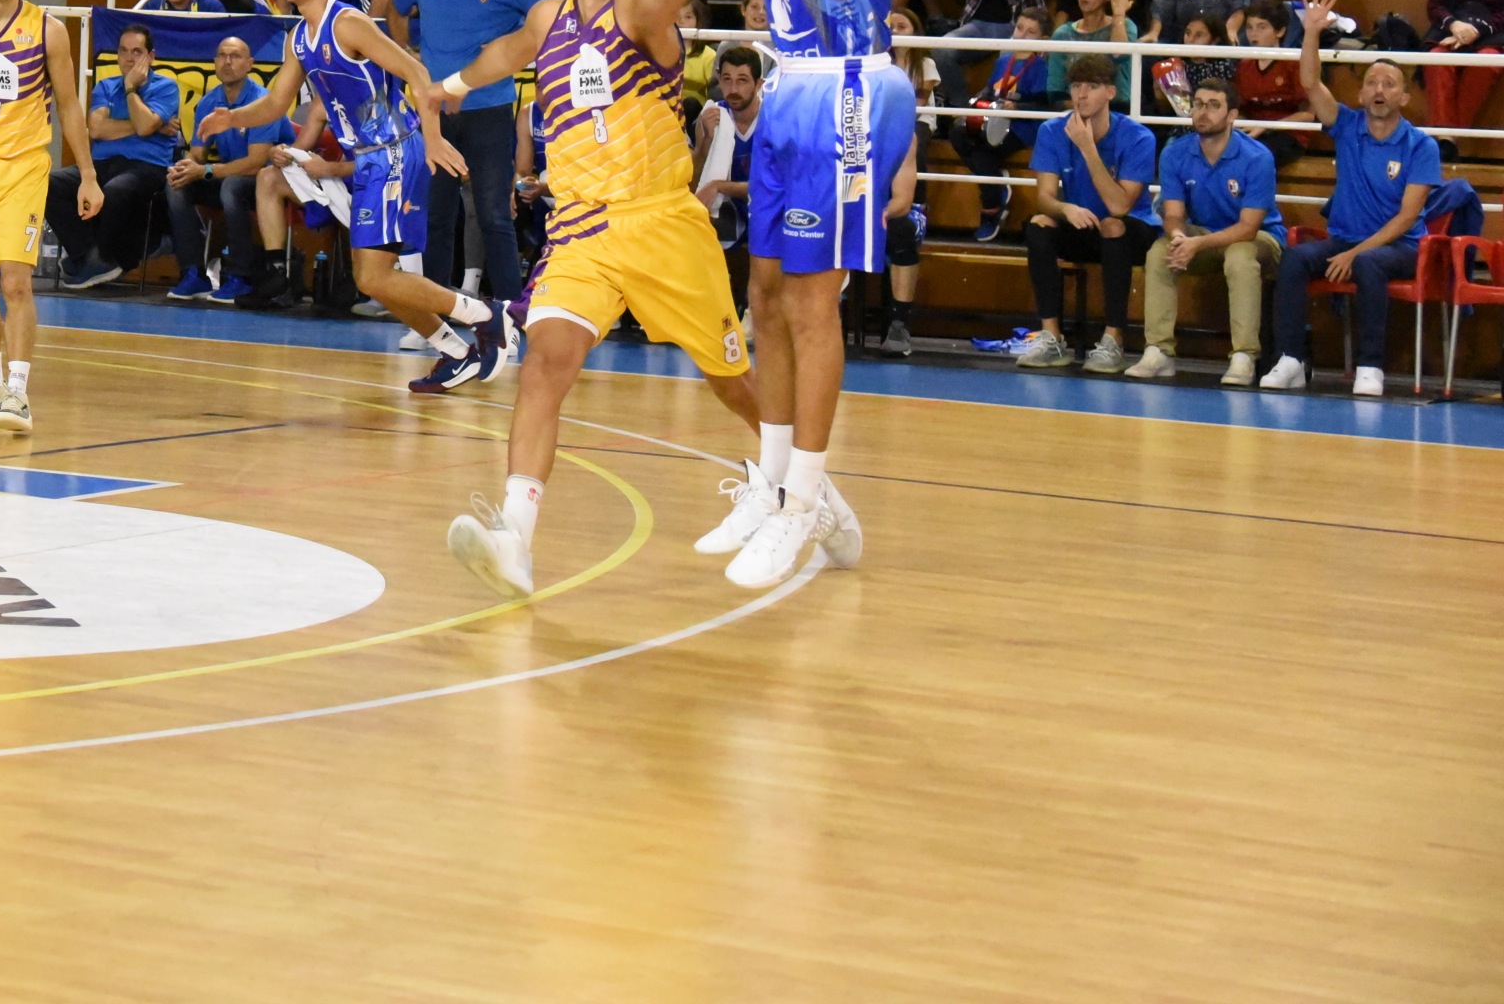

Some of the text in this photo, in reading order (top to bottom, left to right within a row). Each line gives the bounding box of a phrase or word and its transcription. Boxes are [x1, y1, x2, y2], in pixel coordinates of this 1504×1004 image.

[843, 88, 856, 168] Tarragona
[24, 226, 38, 252] 7
[799, 230, 825, 238] Center
[723, 330, 742, 364] 8
